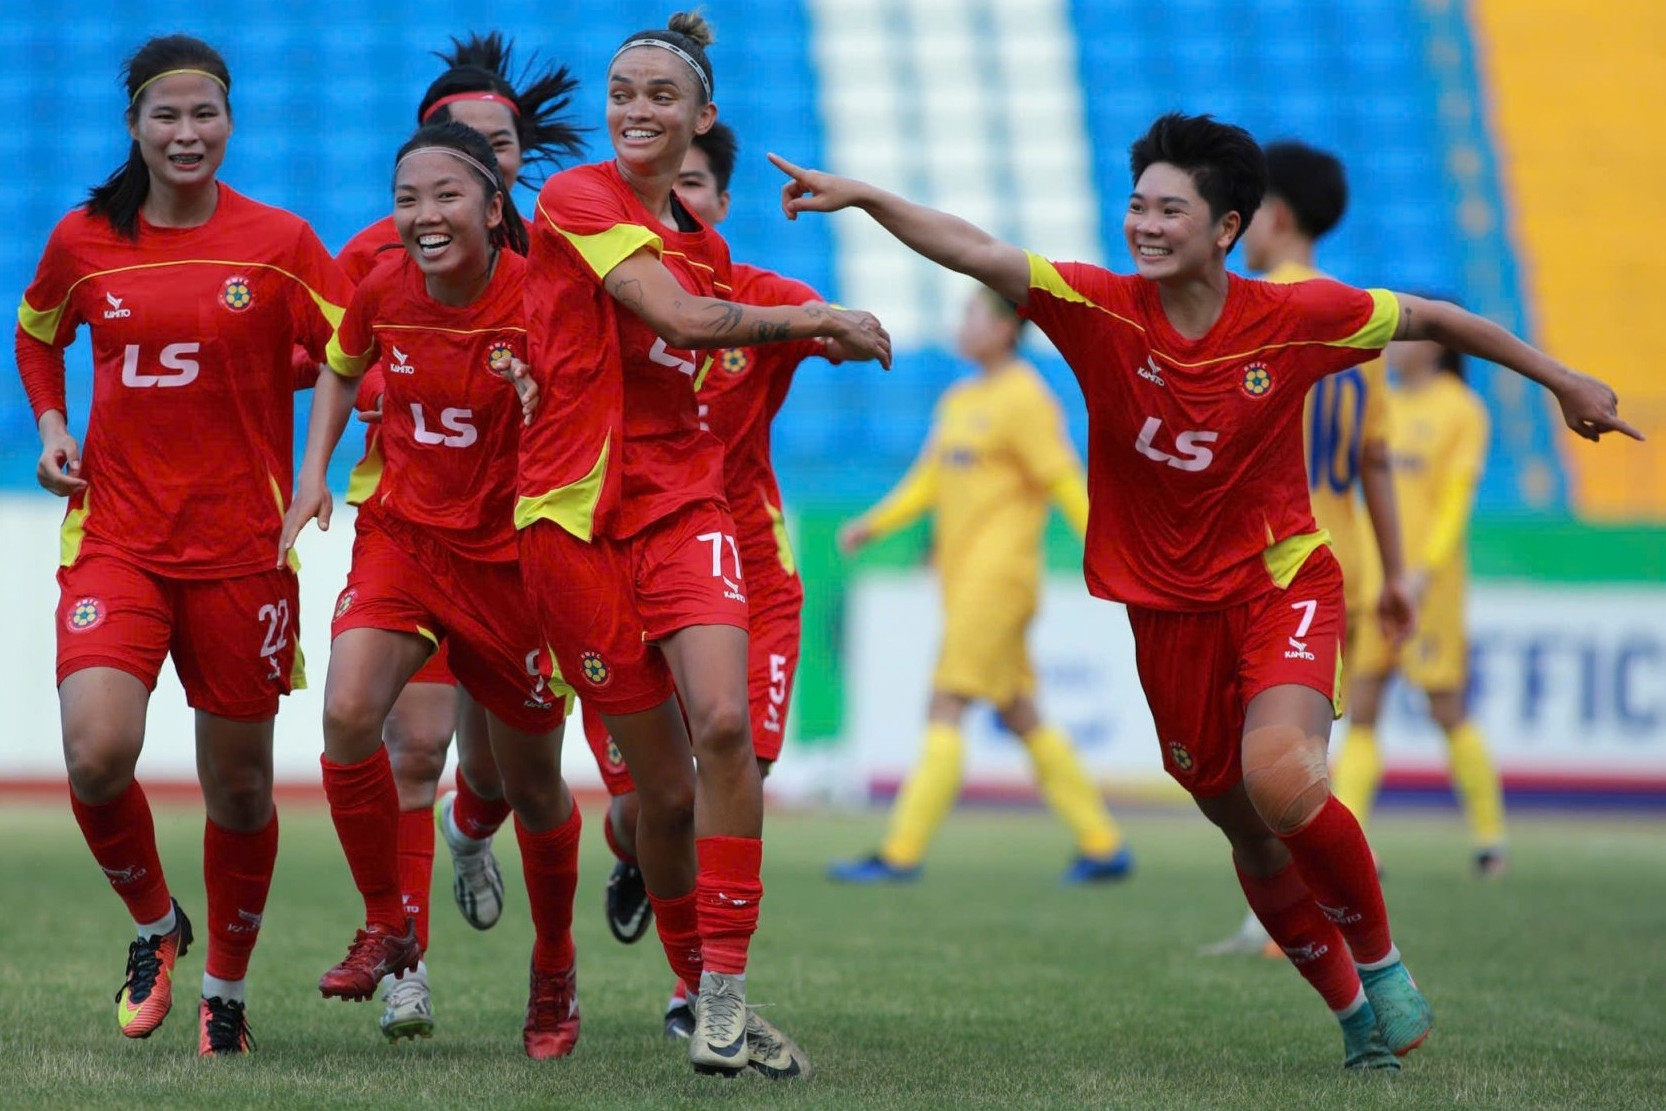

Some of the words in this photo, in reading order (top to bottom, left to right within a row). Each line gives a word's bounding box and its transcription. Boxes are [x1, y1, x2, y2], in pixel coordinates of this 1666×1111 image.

[104, 309, 131, 319] KAMITO
[121, 342, 200, 388] LS
[390, 363, 415, 375] KAMITO
[648, 336, 697, 376] L
[1136, 366, 1165, 387] KAMITO
[409, 402, 478, 448] LS
[1134, 416, 1219, 472] LS
[1310, 367, 1367, 494] 10
[258, 599, 289, 658] 22
[1291, 599, 1317, 637] 7
[1284, 650, 1315, 661] KAMITO
[1400, 627, 1666, 733] FFIC
